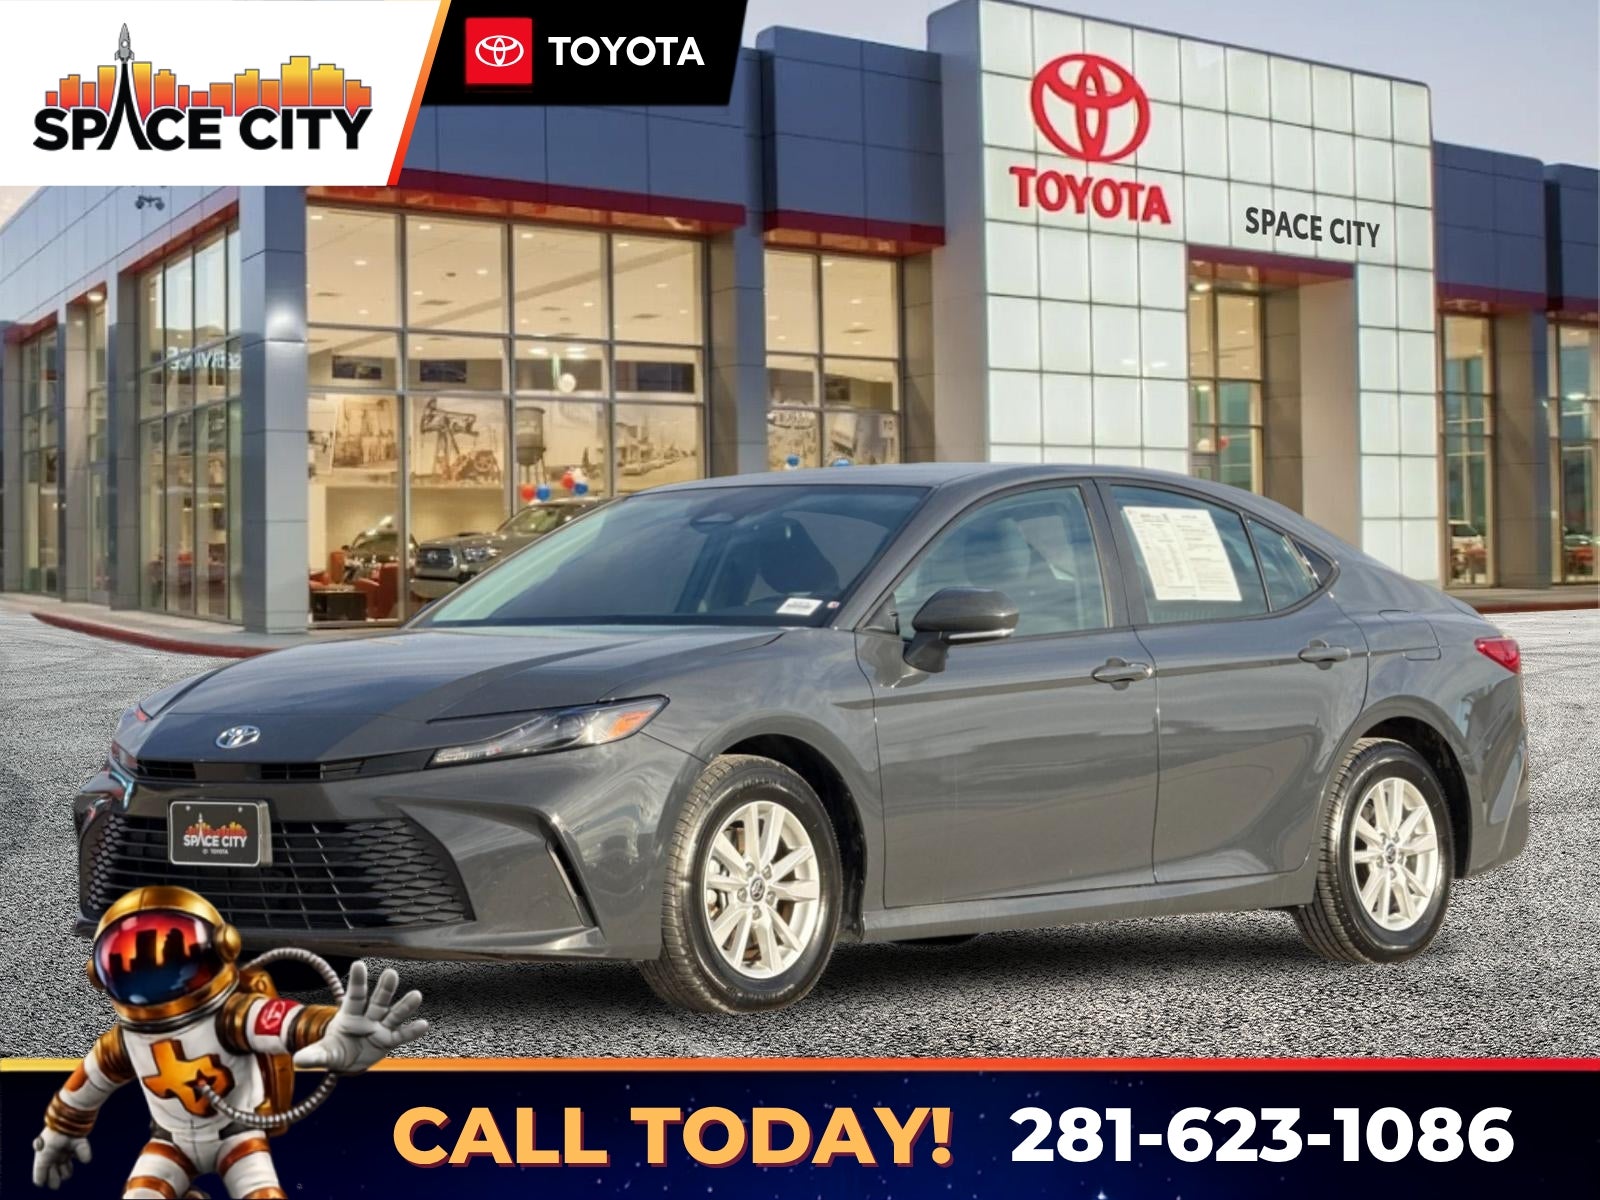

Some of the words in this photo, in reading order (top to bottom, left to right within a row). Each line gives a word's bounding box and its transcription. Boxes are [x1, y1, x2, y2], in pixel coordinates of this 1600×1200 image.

[1010, 166, 1171, 225] TOYOTA
[1245, 206, 1323, 242] SPACE
[1329, 217, 1381, 248] CITY
[183, 834, 220, 847] SPACE
[221, 835, 248, 848] CITY
